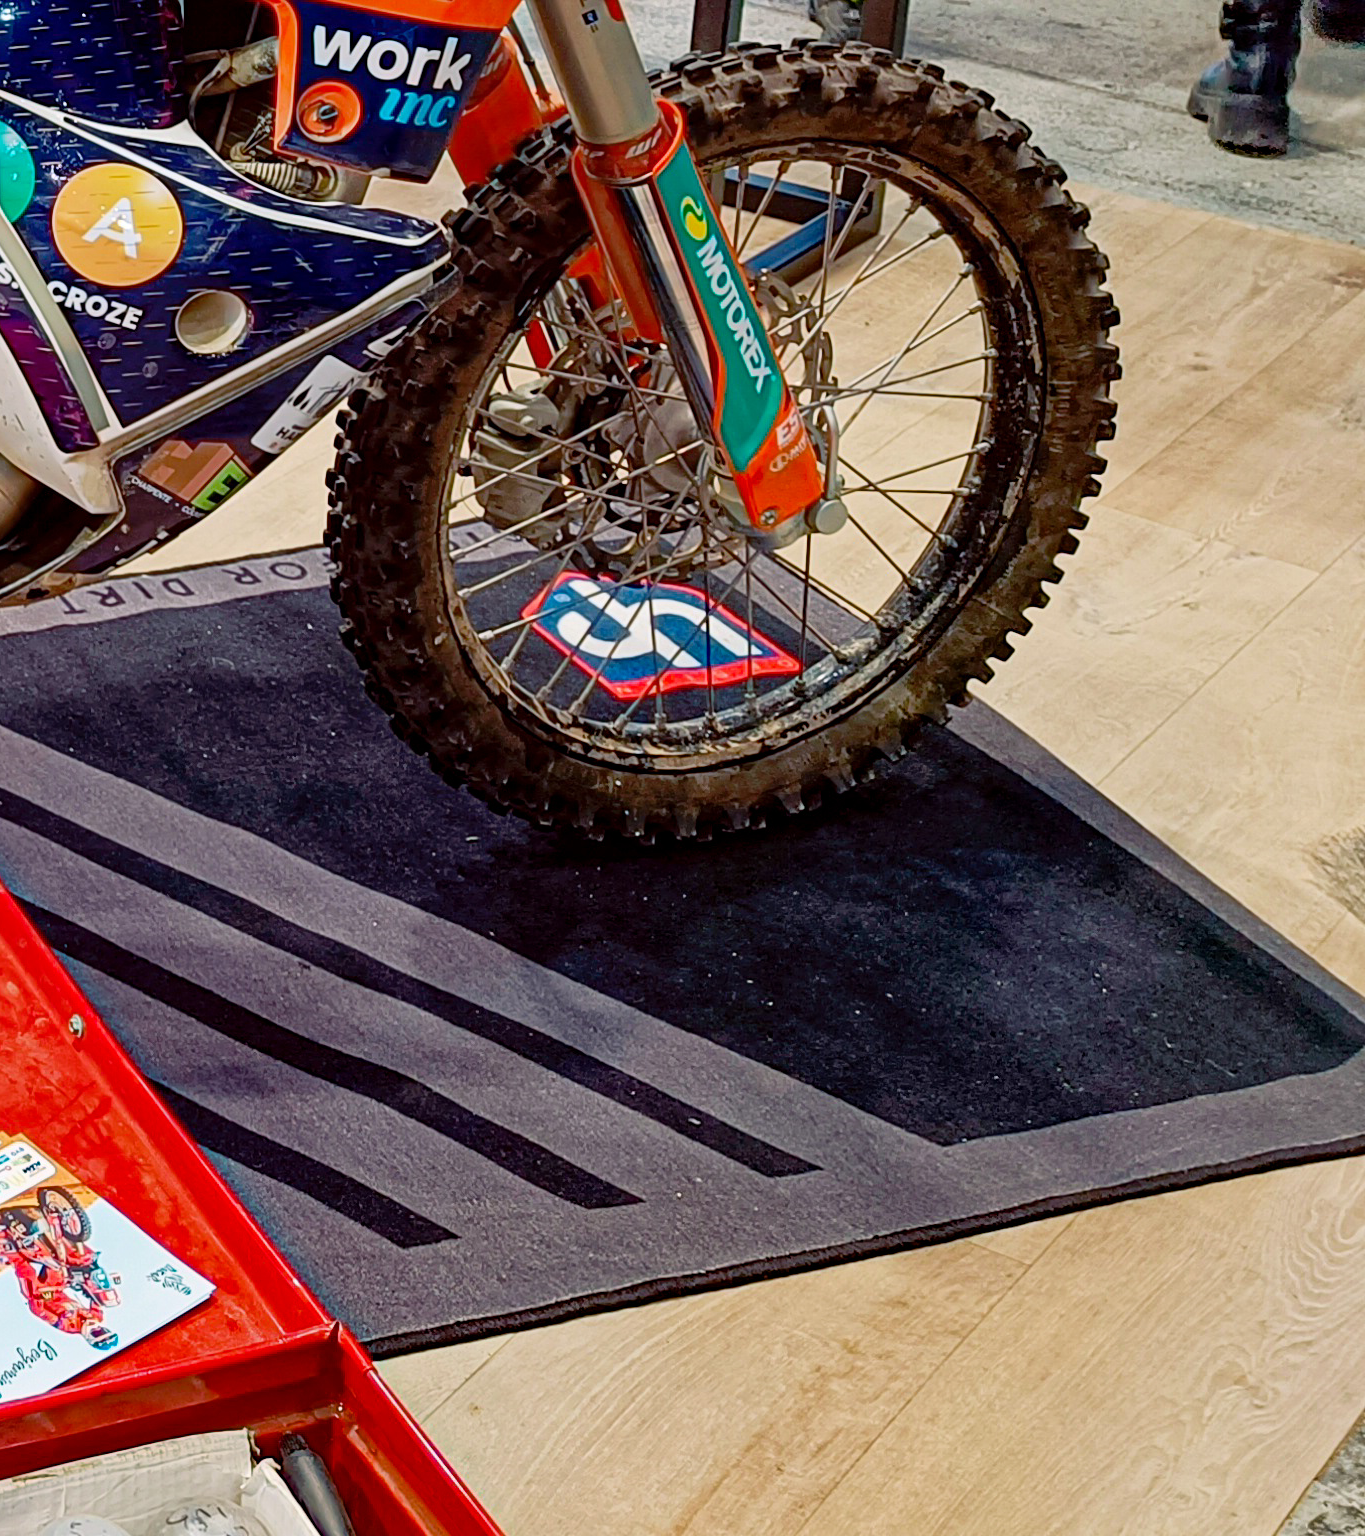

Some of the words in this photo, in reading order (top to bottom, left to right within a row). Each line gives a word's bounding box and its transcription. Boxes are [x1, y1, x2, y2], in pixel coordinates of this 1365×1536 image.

[313, 25, 471, 92] work
[380, 87, 457, 129] inc
[694, 236, 772, 395] MOTOREX
[131, 476, 173, 504] CHARPENTE
